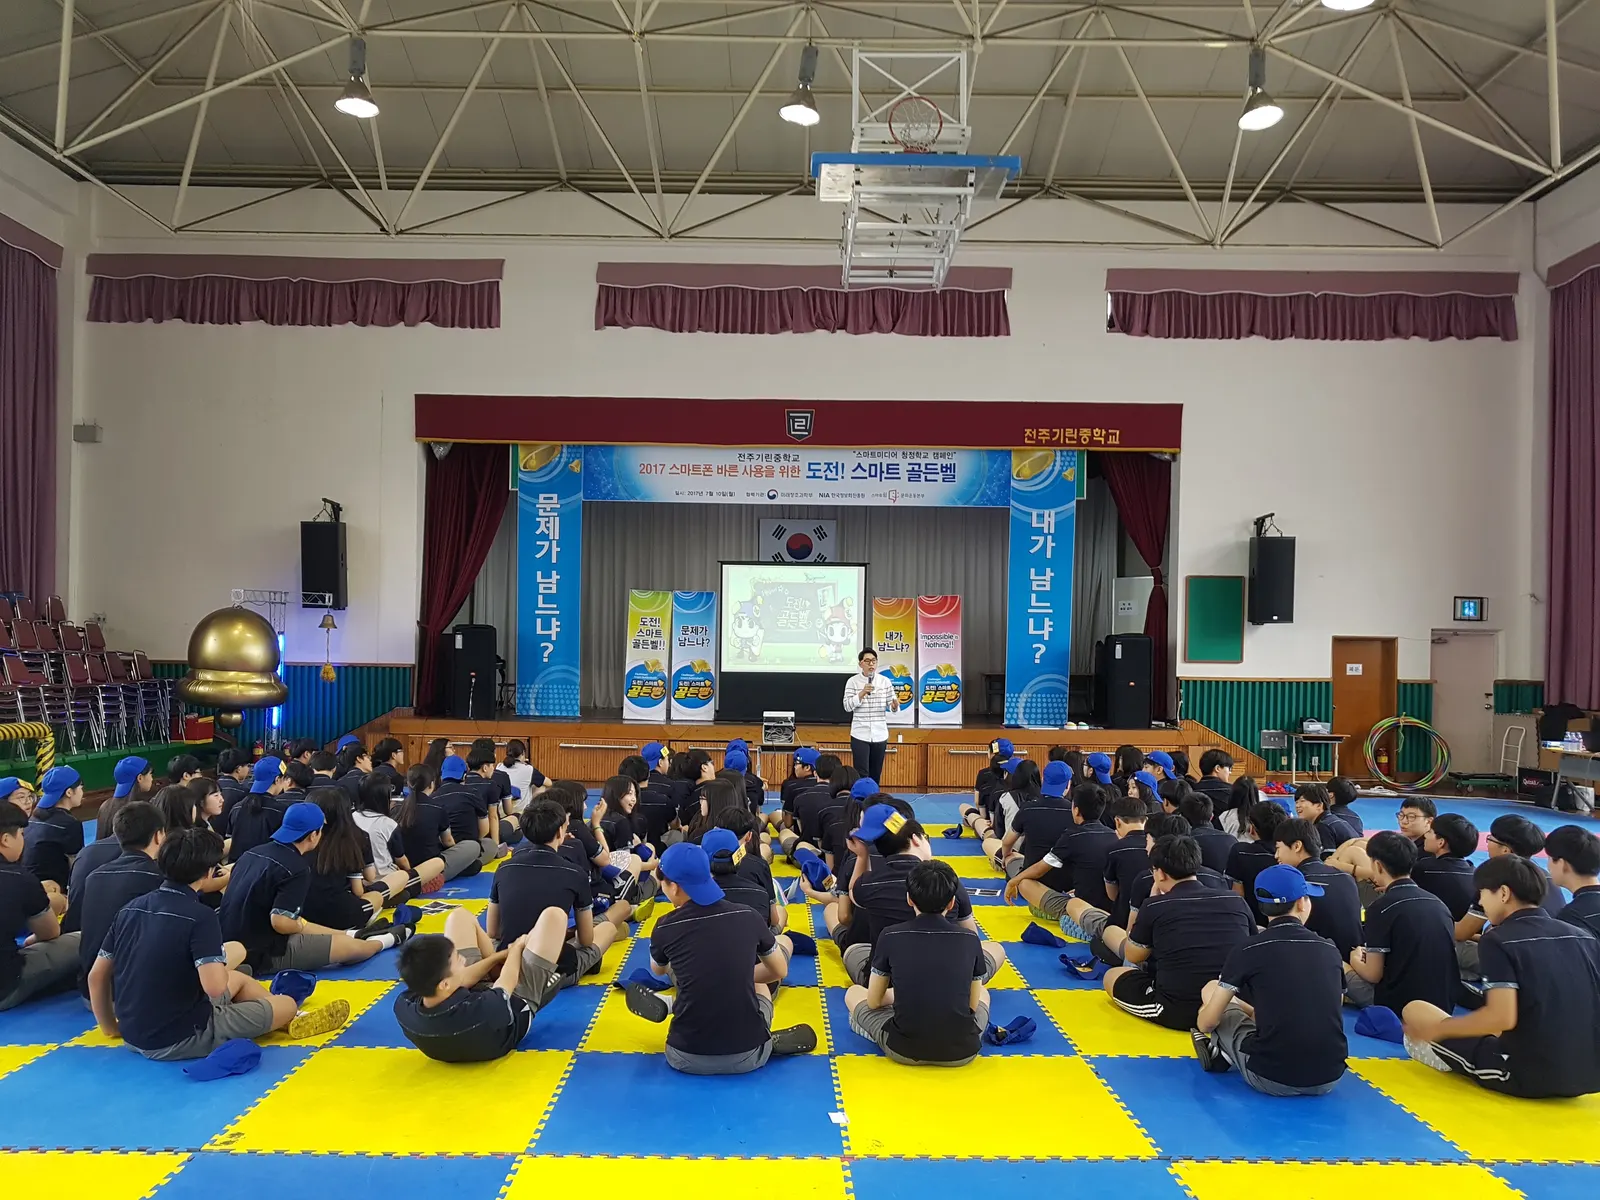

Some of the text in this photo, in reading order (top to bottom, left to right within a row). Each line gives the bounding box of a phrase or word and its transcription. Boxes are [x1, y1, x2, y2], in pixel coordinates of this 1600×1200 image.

[1024, 427, 1120, 445] 전주기린중학교
[737, 453, 800, 462] 전주기린중학교
[853, 450, 898, 459] "스마트미디어
[901, 451, 929, 459] 청정학교
[639, 461, 956, 482] 2017 스마트폰 바른 사용을 위한 도전! 스마트 골든벨
[535, 494, 560, 662] 문제가 남느냐?
[1027, 567, 1054, 664] 남느냐?
[639, 617, 661, 628] 도전!
[636, 629, 663, 639] 스마트
[681, 626, 708, 636] 문제가
[885, 632, 903, 641] 내가
[632, 639, 666, 650] 골든벨!!
[678, 638, 711, 648] 남느냐?
[877, 643, 910, 653] 남느냐?
[924, 641, 954, 649] Nothing!!
